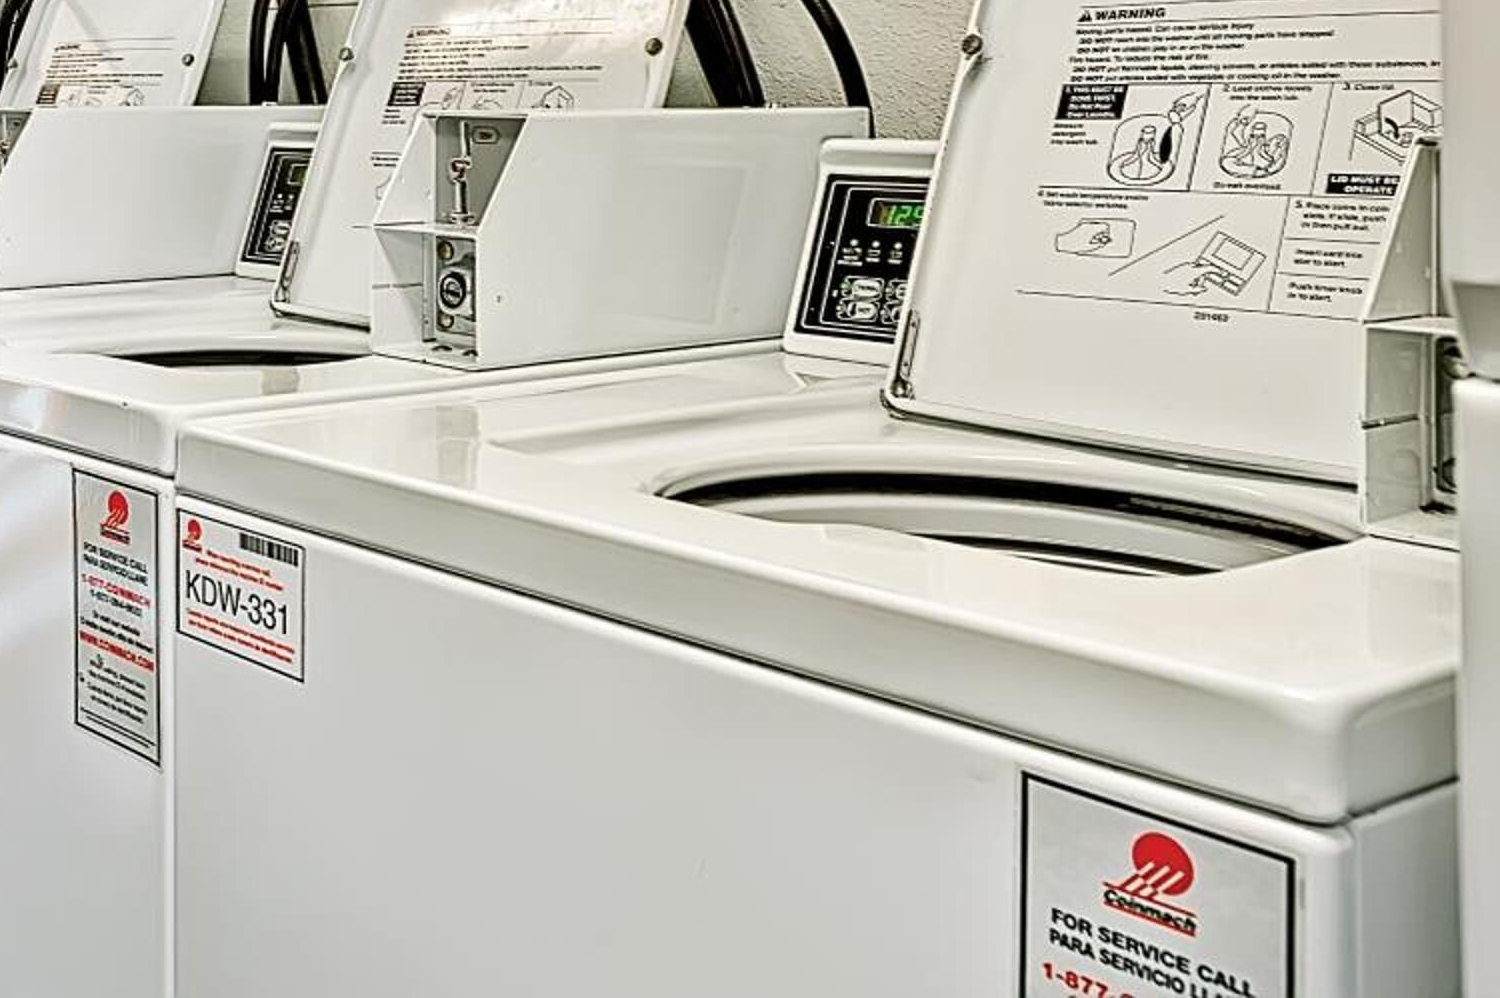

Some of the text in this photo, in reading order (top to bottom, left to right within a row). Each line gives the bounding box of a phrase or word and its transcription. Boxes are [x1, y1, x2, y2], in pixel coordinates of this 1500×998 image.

[1095, 7, 1166, 21] WARNING
[186, 569, 288, 635] KDW-331
[1103, 889, 1197, 932] Coinmach
[1049, 928, 1185, 995] PARA SERVICIO
[1051, 907, 1092, 937] FOR
[1097, 925, 1191, 975] SERVICE
[1197, 965, 1256, 998] CALL
